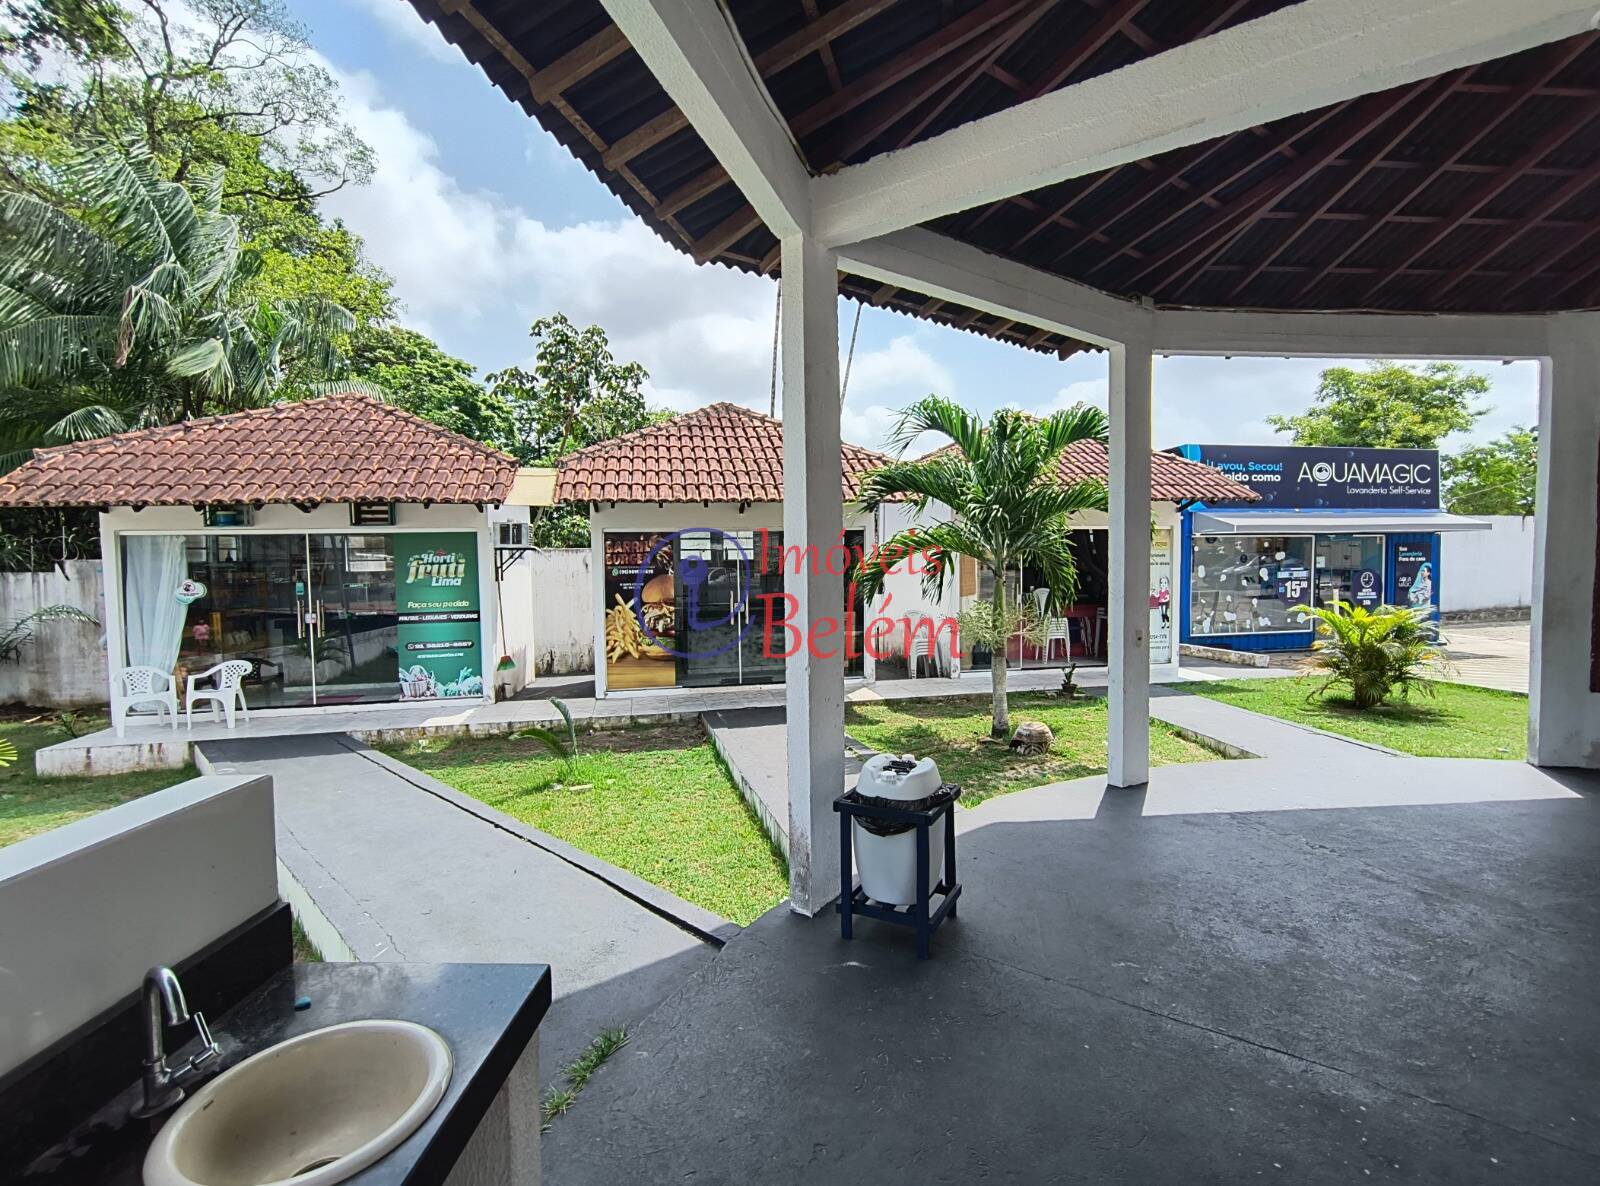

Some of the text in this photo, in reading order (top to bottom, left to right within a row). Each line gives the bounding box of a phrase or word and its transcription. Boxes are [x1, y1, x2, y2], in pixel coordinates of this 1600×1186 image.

[1247, 461, 1283, 471] Secou!
[1221, 472, 1281, 482] pido como
[1297, 461, 1432, 485] AQUAMAGIC
[1346, 485, 1431, 495] Lavanderia Self-Service
[421, 552, 456, 563] Horti
[406, 559, 466, 584] fruti
[431, 577, 462, 587] Lima
[407, 601, 427, 609] Faça
[442, 600, 469, 608] pedido
